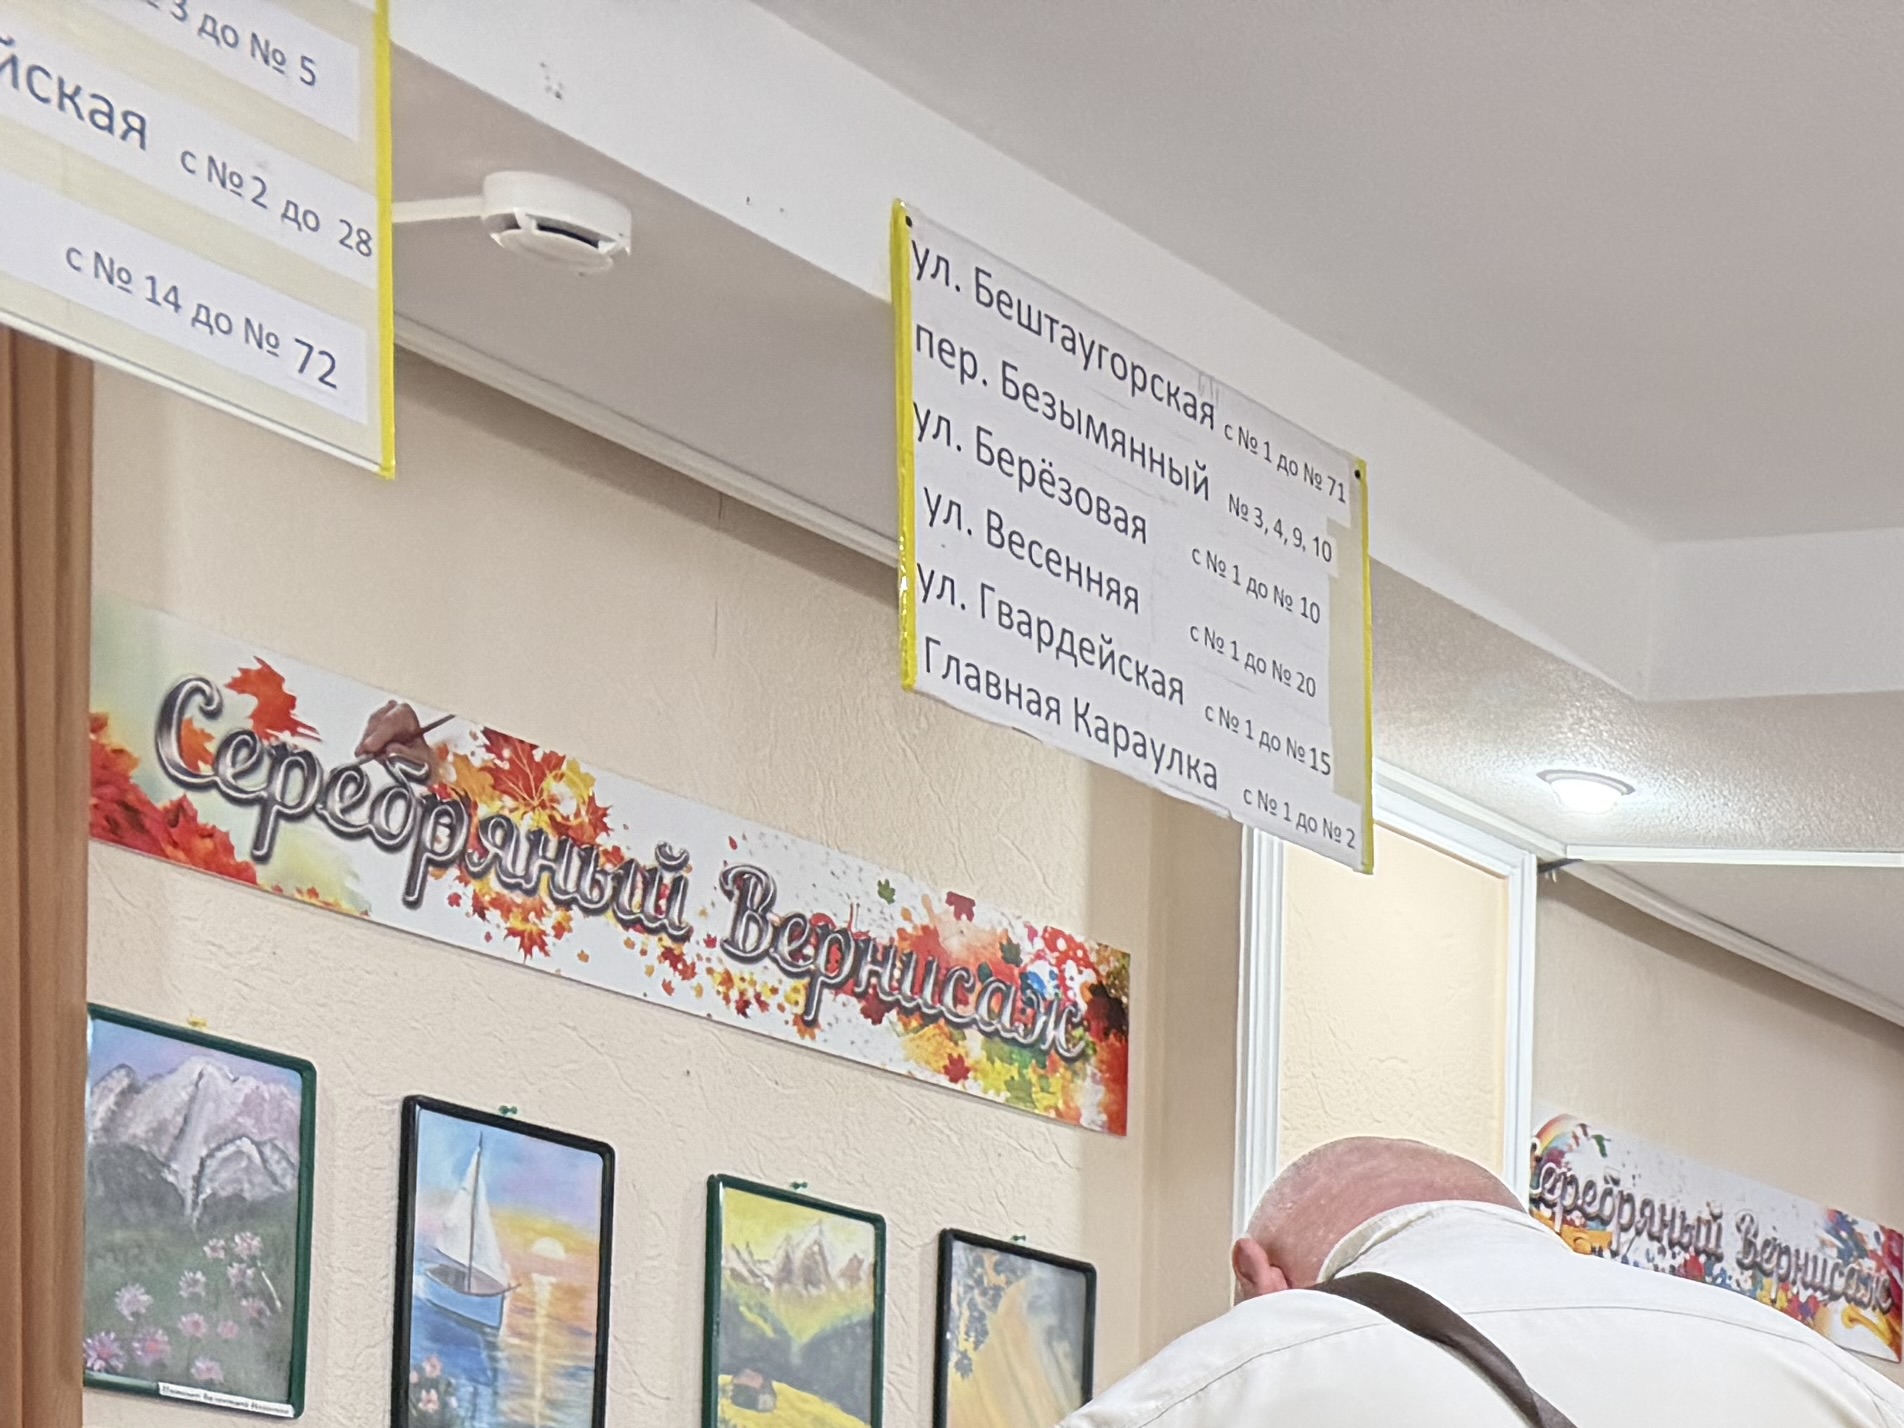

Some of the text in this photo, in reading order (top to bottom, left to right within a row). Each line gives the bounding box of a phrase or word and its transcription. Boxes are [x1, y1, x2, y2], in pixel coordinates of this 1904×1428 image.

[198, 13, 239, 51] до
[250, 32, 287, 74] №
[299, 55, 316, 87] 5
[180, 149, 197, 175] с
[206, 155, 244, 197] №
[251, 176, 268, 209] 2
[281, 199, 320, 233] до
[338, 218, 373, 258] 28
[65, 246, 338, 390] с № 14 до № 72
[911, 239, 1346, 504] ул. Бештаугорская с № 1 до № 71
[913, 401, 1320, 624] ул. Берёзовая с № 1 до № 10
[916, 323, 988, 387] пер.
[1002, 359, 1209, 501] Безымянный
[1254, 507, 1269, 536] 3,
[1273, 518, 1288, 546] 4,
[1312, 537, 1332, 563] 10
[917, 563, 1331, 775] ул. Гвардейская с № 1 до № 15
[924, 487, 1316, 698] ул. Весенняя с № 1 до № 20
[925, 636, 1356, 849] Главная Караулка с № 1 до № 2
[153, 671, 1093, 1065] Серебряный Вернисаж
[1734, 1207, 1895, 1315] Вернисаж
